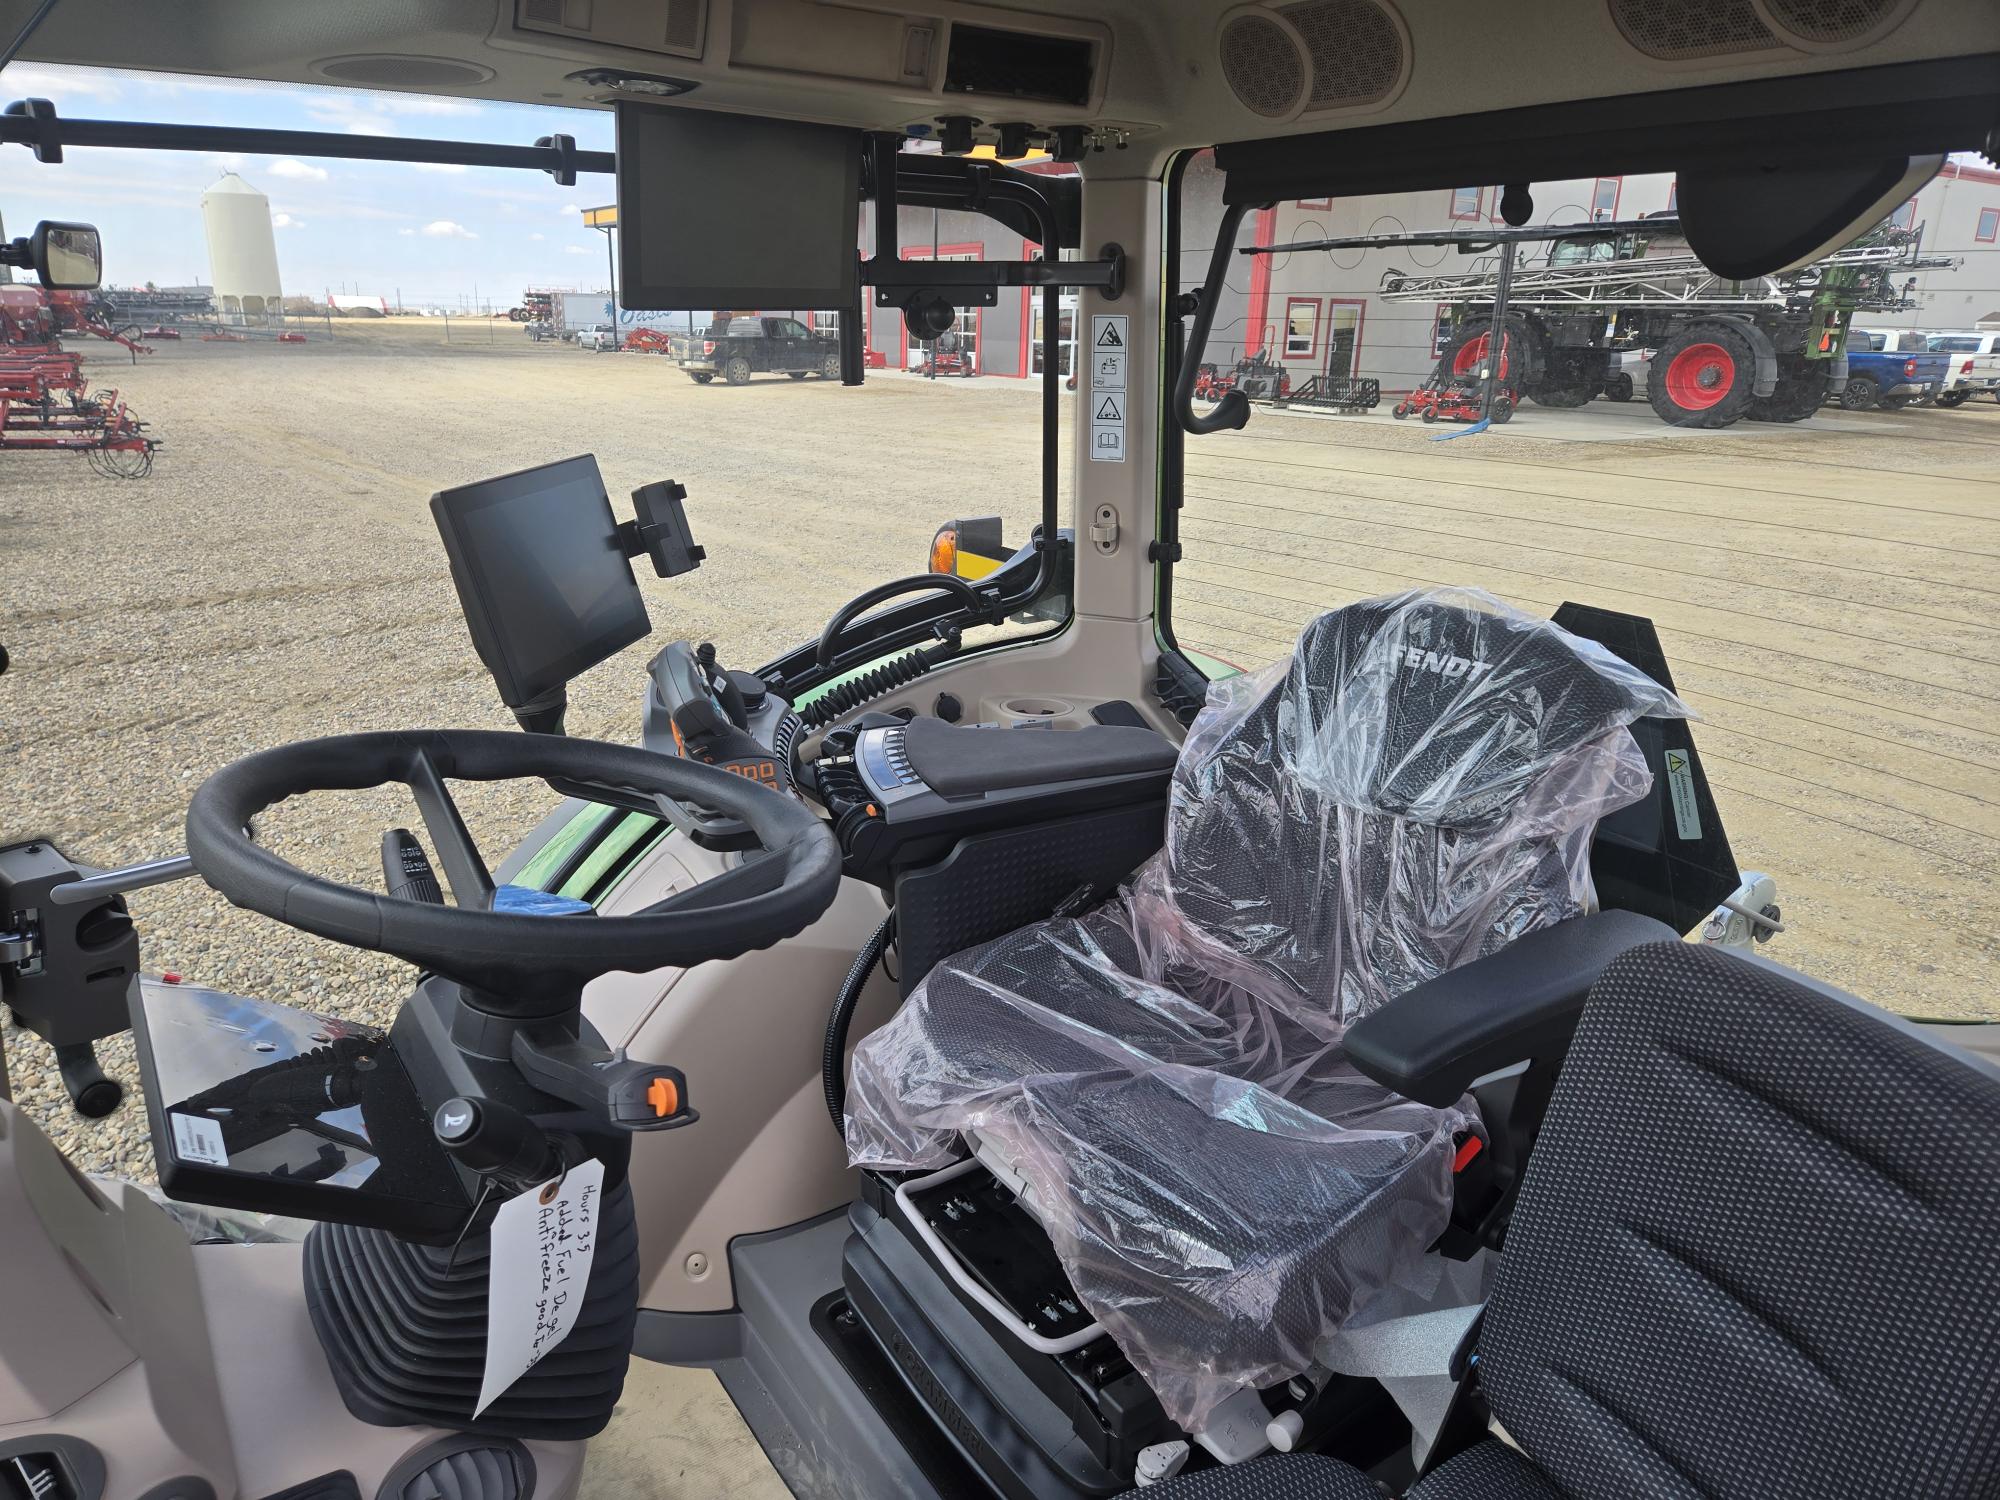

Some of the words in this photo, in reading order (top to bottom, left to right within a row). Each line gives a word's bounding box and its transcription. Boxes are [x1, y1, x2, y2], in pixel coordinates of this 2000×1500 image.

[1390, 643, 1494, 681] FENDT
[580, 1185, 597, 1222] Hours
[557, 1200, 574, 1245] Added
[577, 1231, 590, 1252] 3.5
[555, 1249, 572, 1284] Fuel
[535, 1299, 547, 1336] good
